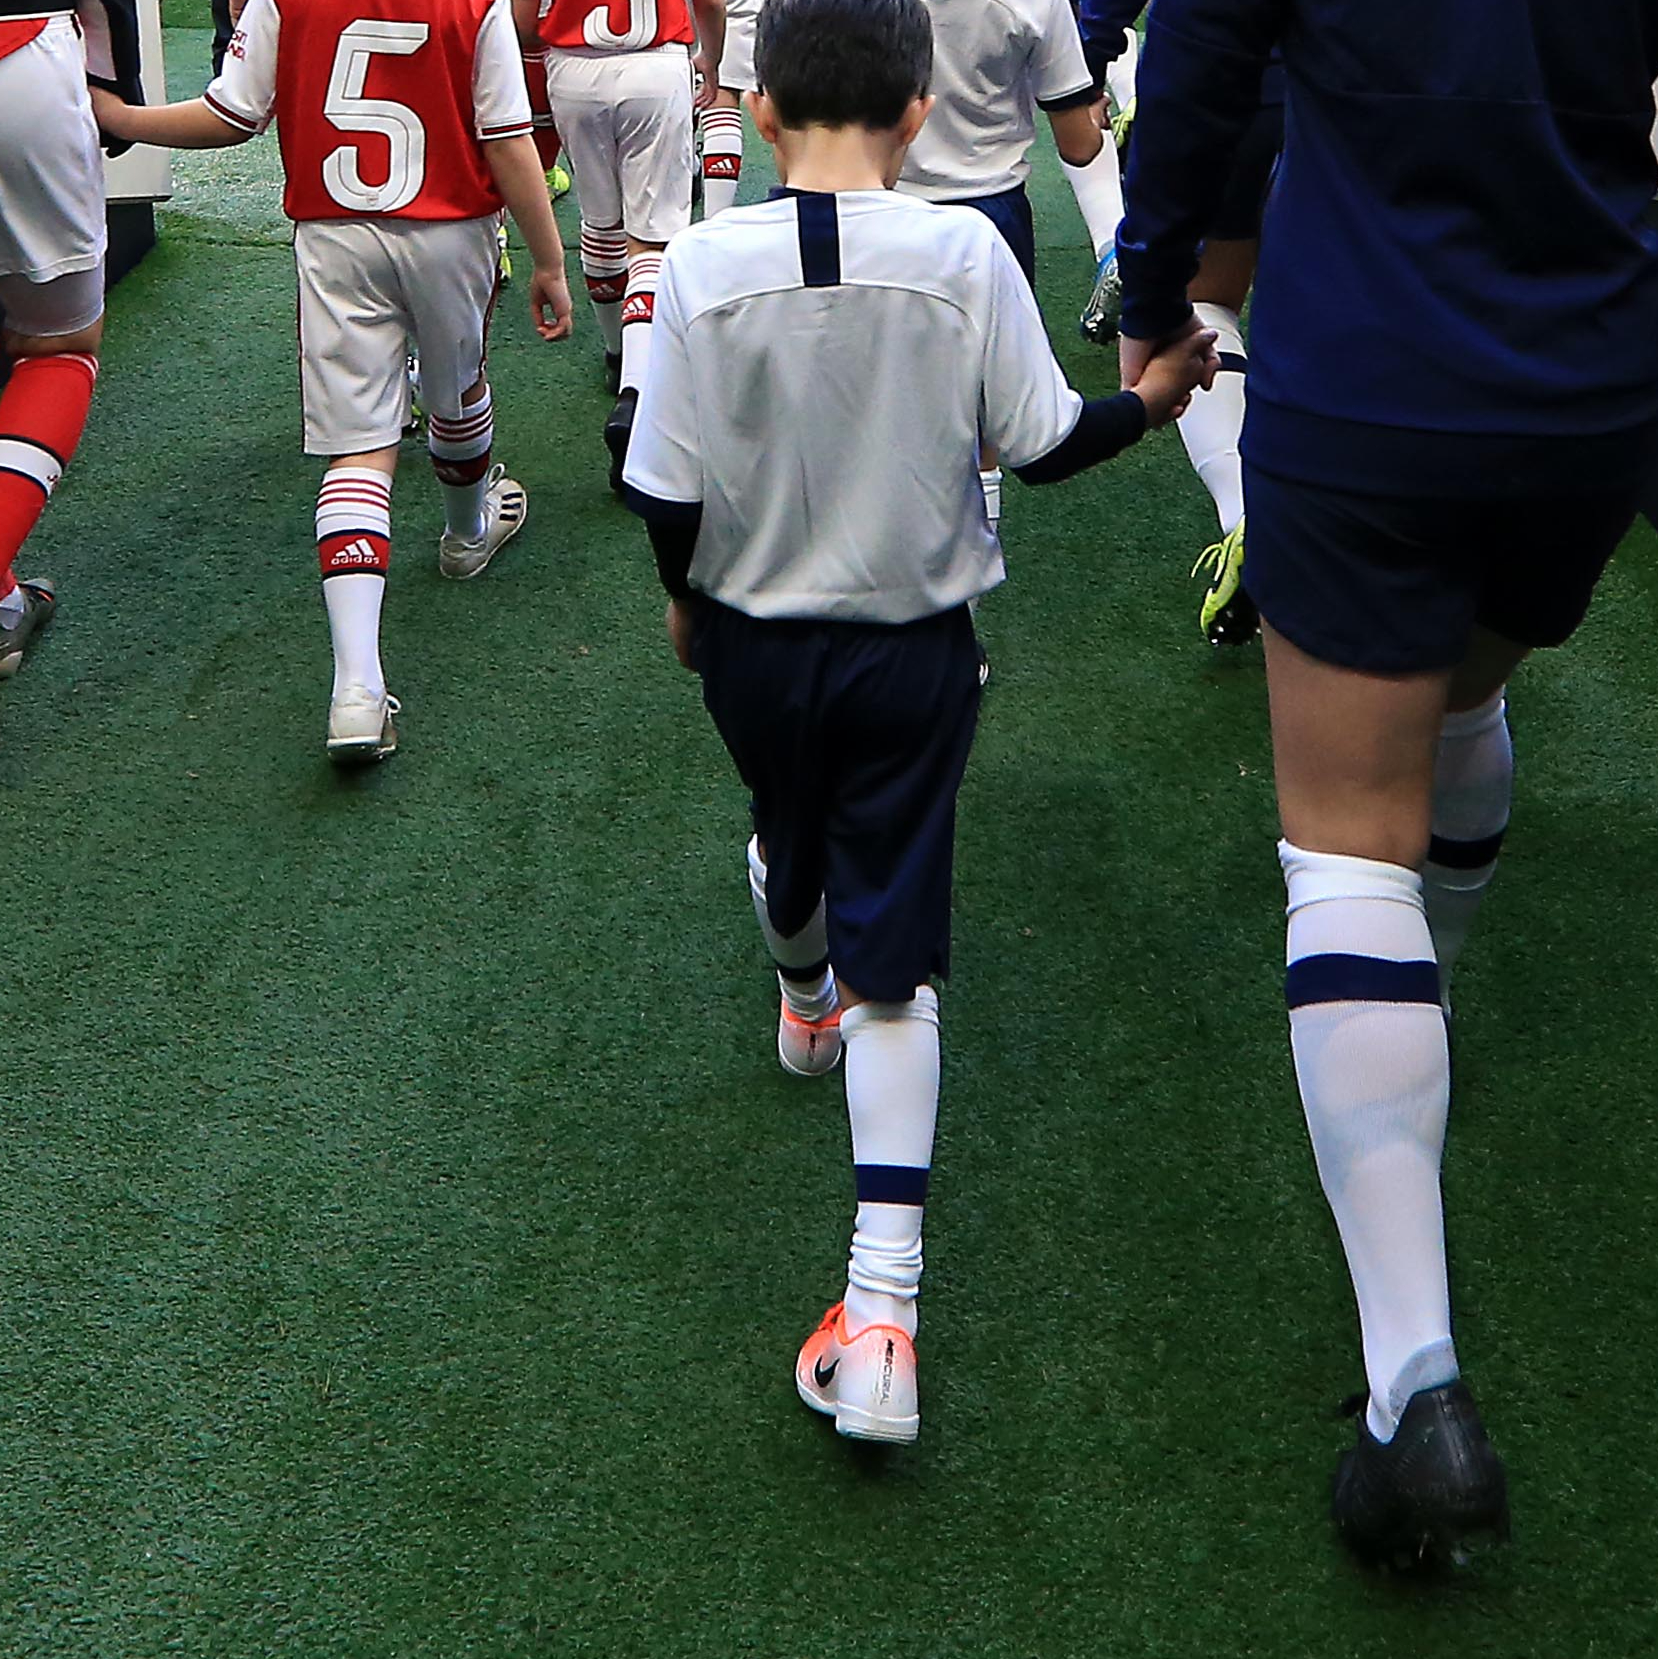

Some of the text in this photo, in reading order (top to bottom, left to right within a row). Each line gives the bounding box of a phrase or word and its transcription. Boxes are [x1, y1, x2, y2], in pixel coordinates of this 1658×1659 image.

[322, 20, 430, 213] 5
[330, 554, 381, 565] adidas
[879, 1338, 895, 1406] MERCURIAL
